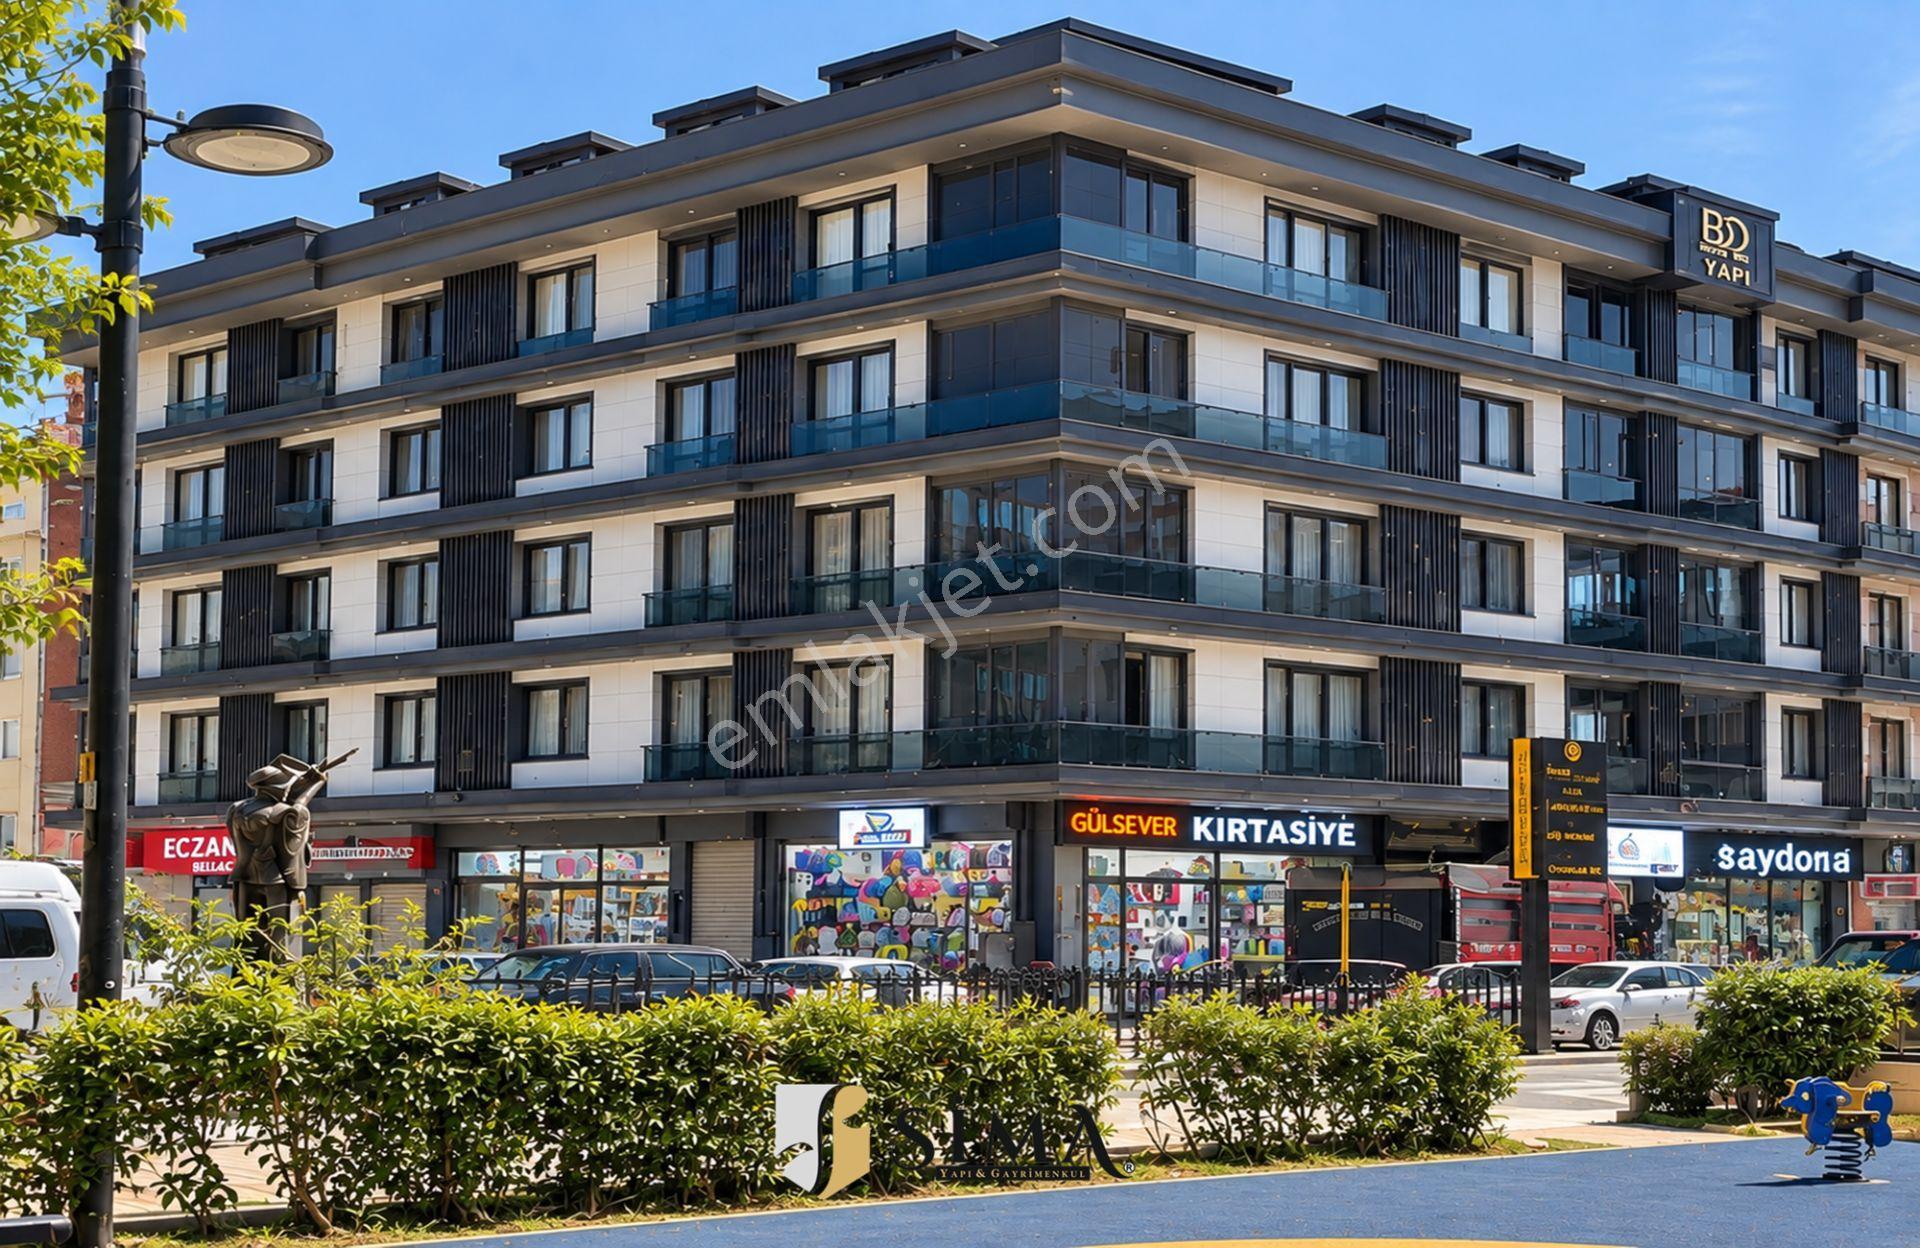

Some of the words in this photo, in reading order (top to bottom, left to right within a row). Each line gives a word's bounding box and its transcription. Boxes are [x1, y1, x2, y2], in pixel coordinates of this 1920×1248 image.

[1704, 257, 1750, 287] YAPI
[1070, 807, 1178, 837] GÜLSEVER
[1192, 814, 1357, 847] KIRTASİYE
[1717, 842, 1851, 877] saydona
